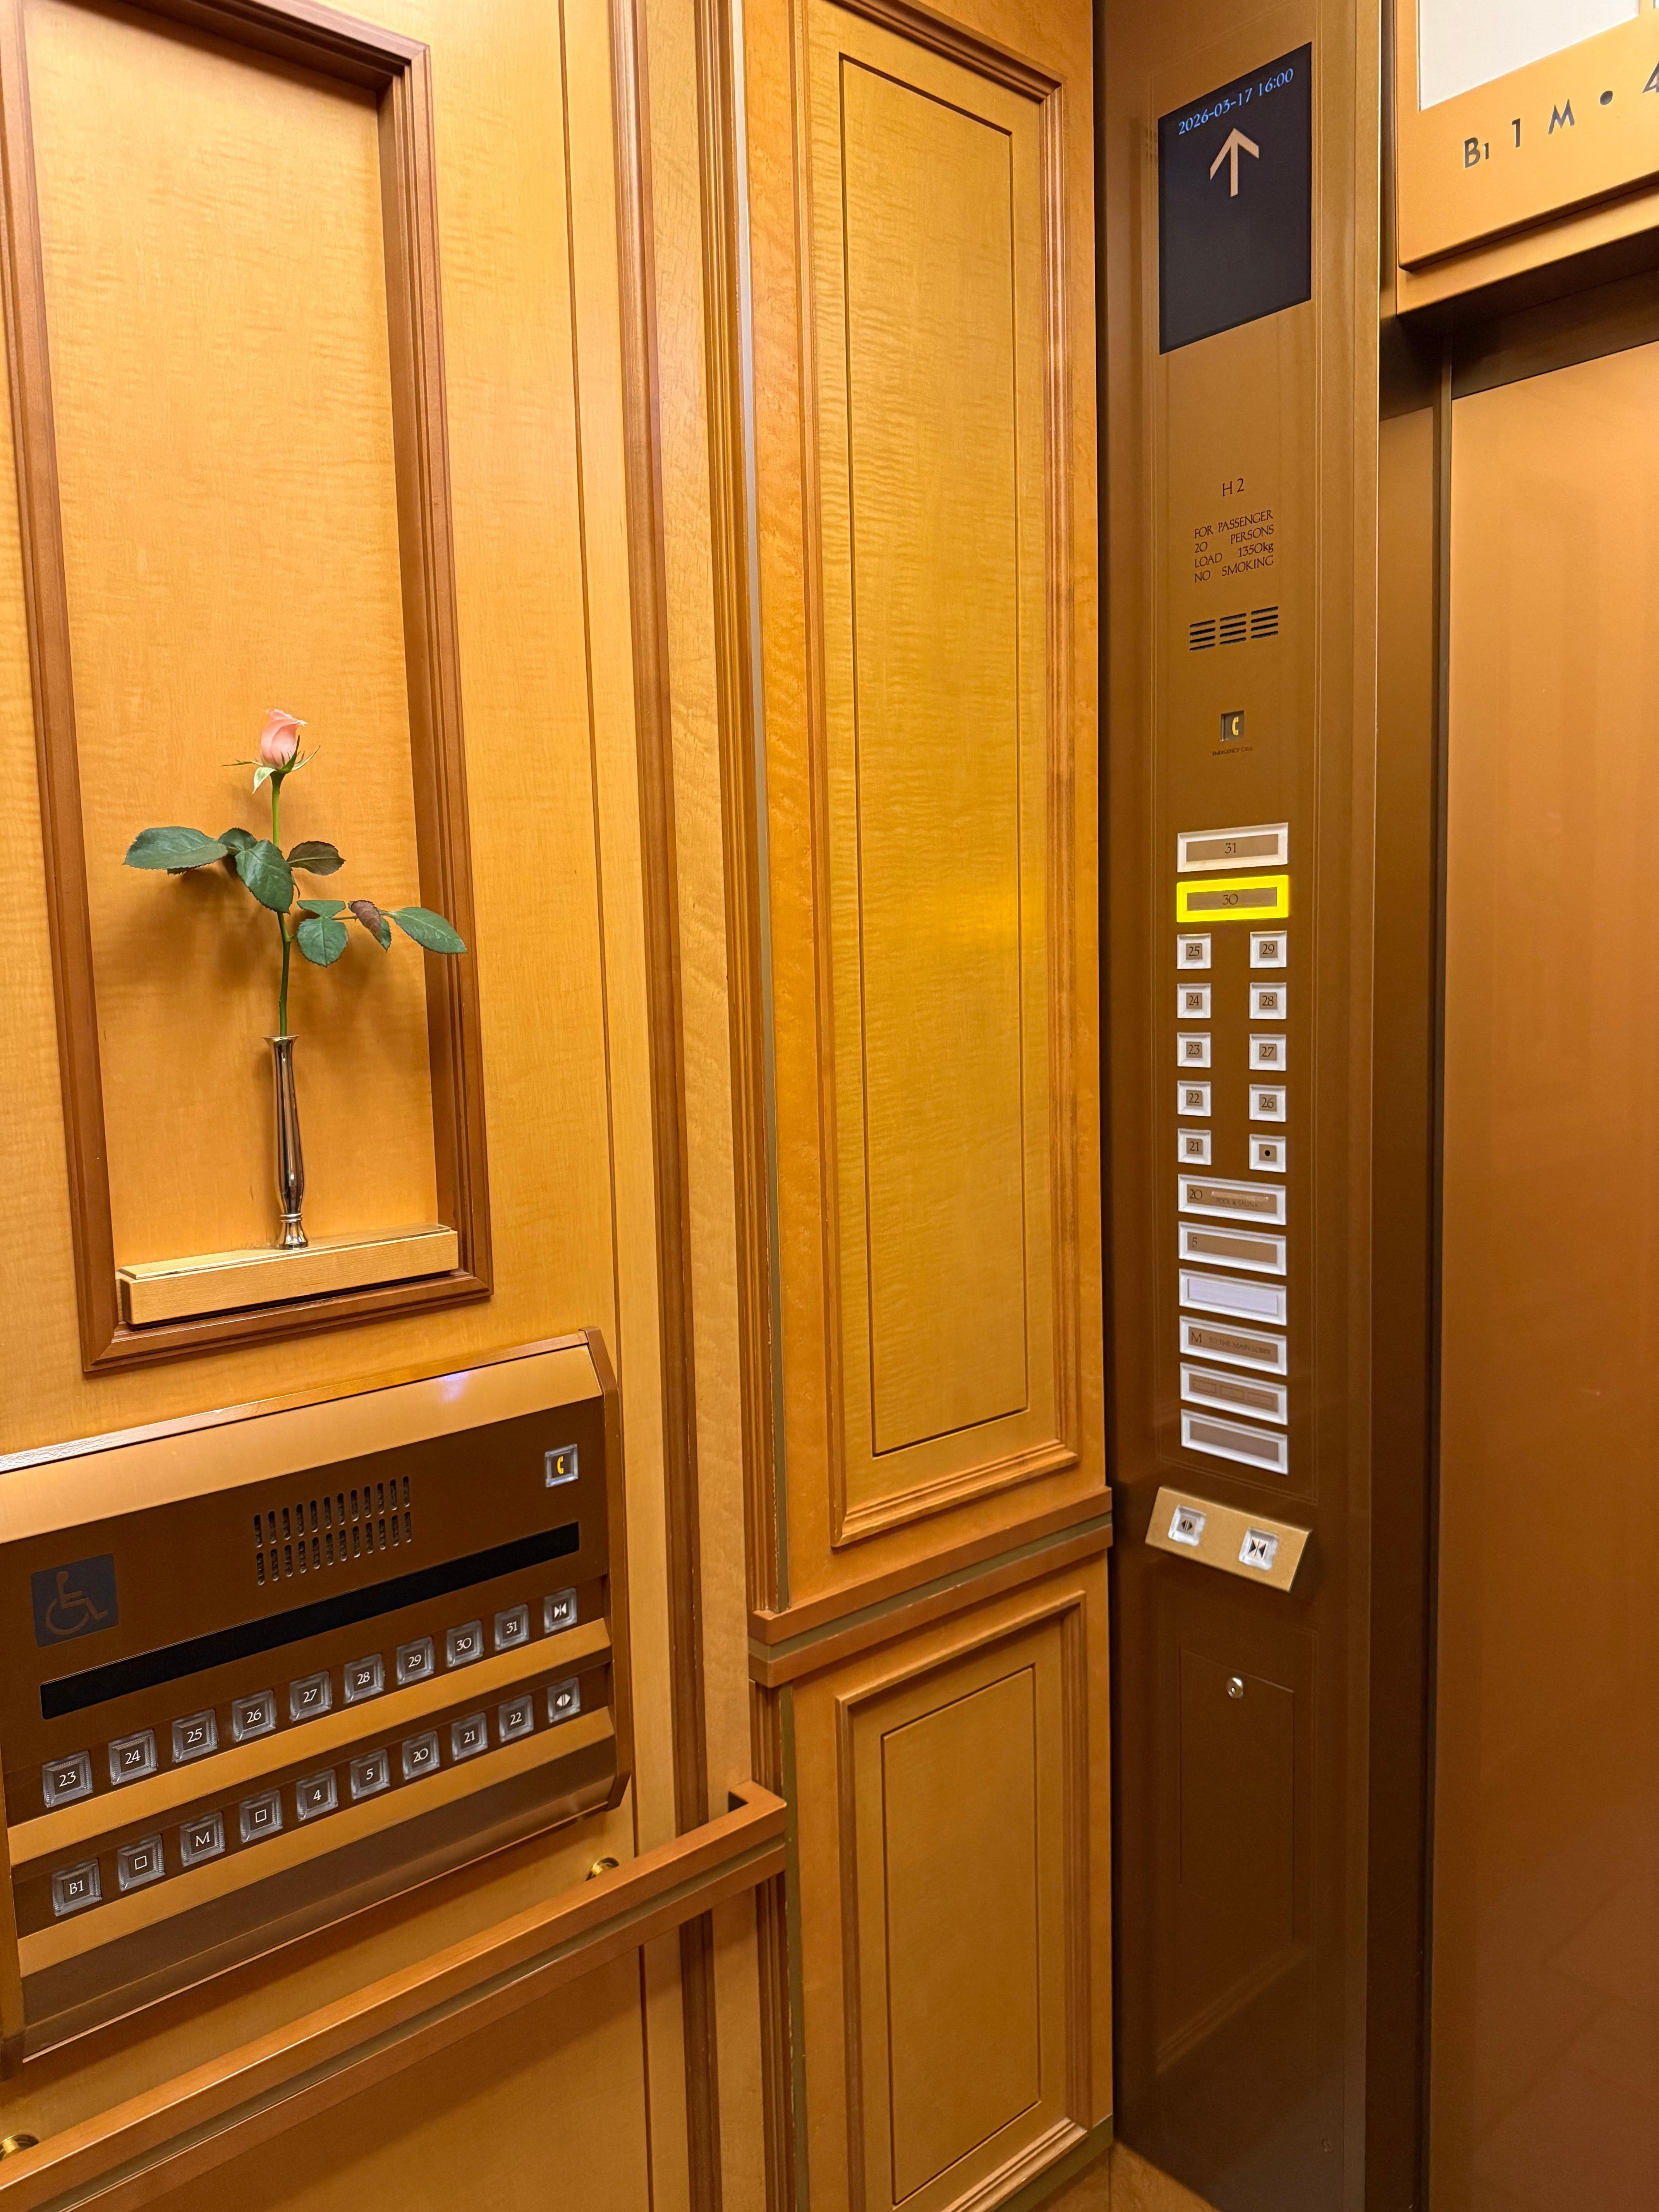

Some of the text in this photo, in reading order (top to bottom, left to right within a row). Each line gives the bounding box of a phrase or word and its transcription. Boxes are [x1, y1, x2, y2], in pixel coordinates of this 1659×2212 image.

[1178, 68, 1293, 135] 2026-03-17 16:00
[1511, 118, 1520, 148] 1
[1548, 99, 1575, 134] M
[1194, 510, 1273, 539] FOR PASSENGER
[1195, 524, 1274, 553] 20 PERSONS
[1195, 542, 1274, 568] LOAD 1350kg
[1195, 555, 1274, 582] NO SMOKING
[1224, 842, 1237, 854] 31
[1222, 894, 1238, 905] 30
[1188, 946, 1200, 957] 25
[1262, 944, 1274, 955] 29
[1188, 996, 1200, 1006] 24
[1262, 995, 1274, 1006] 28
[1188, 1044, 1200, 1055] 23
[1261, 1047, 1274, 1057] 27
[1188, 1093, 1200, 1104] 22
[1261, 1097, 1274, 1108] 26
[1189, 1141, 1199, 1152] 21
[1189, 1189, 1203, 1200] 20
[1192, 1237, 1198, 1247] 5
[1191, 1332, 1202, 1344] M
[506, 1621, 518, 1633] 31
[457, 1637, 472, 1650] 30
[409, 1654, 422, 1666] 29
[357, 1671, 370, 1684] 28
[303, 1689, 318, 1702] 27
[247, 1709, 262, 1723] 26
[510, 1712, 522, 1725] 22
[187, 1728, 203, 1743] 25
[464, 1730, 475, 1743] 21
[125, 1750, 141, 1765] 24
[413, 1748, 428, 1763] 20
[59, 1771, 76, 1787] 23
[366, 1768, 373, 1780] 5
[313, 1789, 322, 1802] 4
[195, 1831, 211, 1847] M
[69, 1880, 84, 1894] B1
